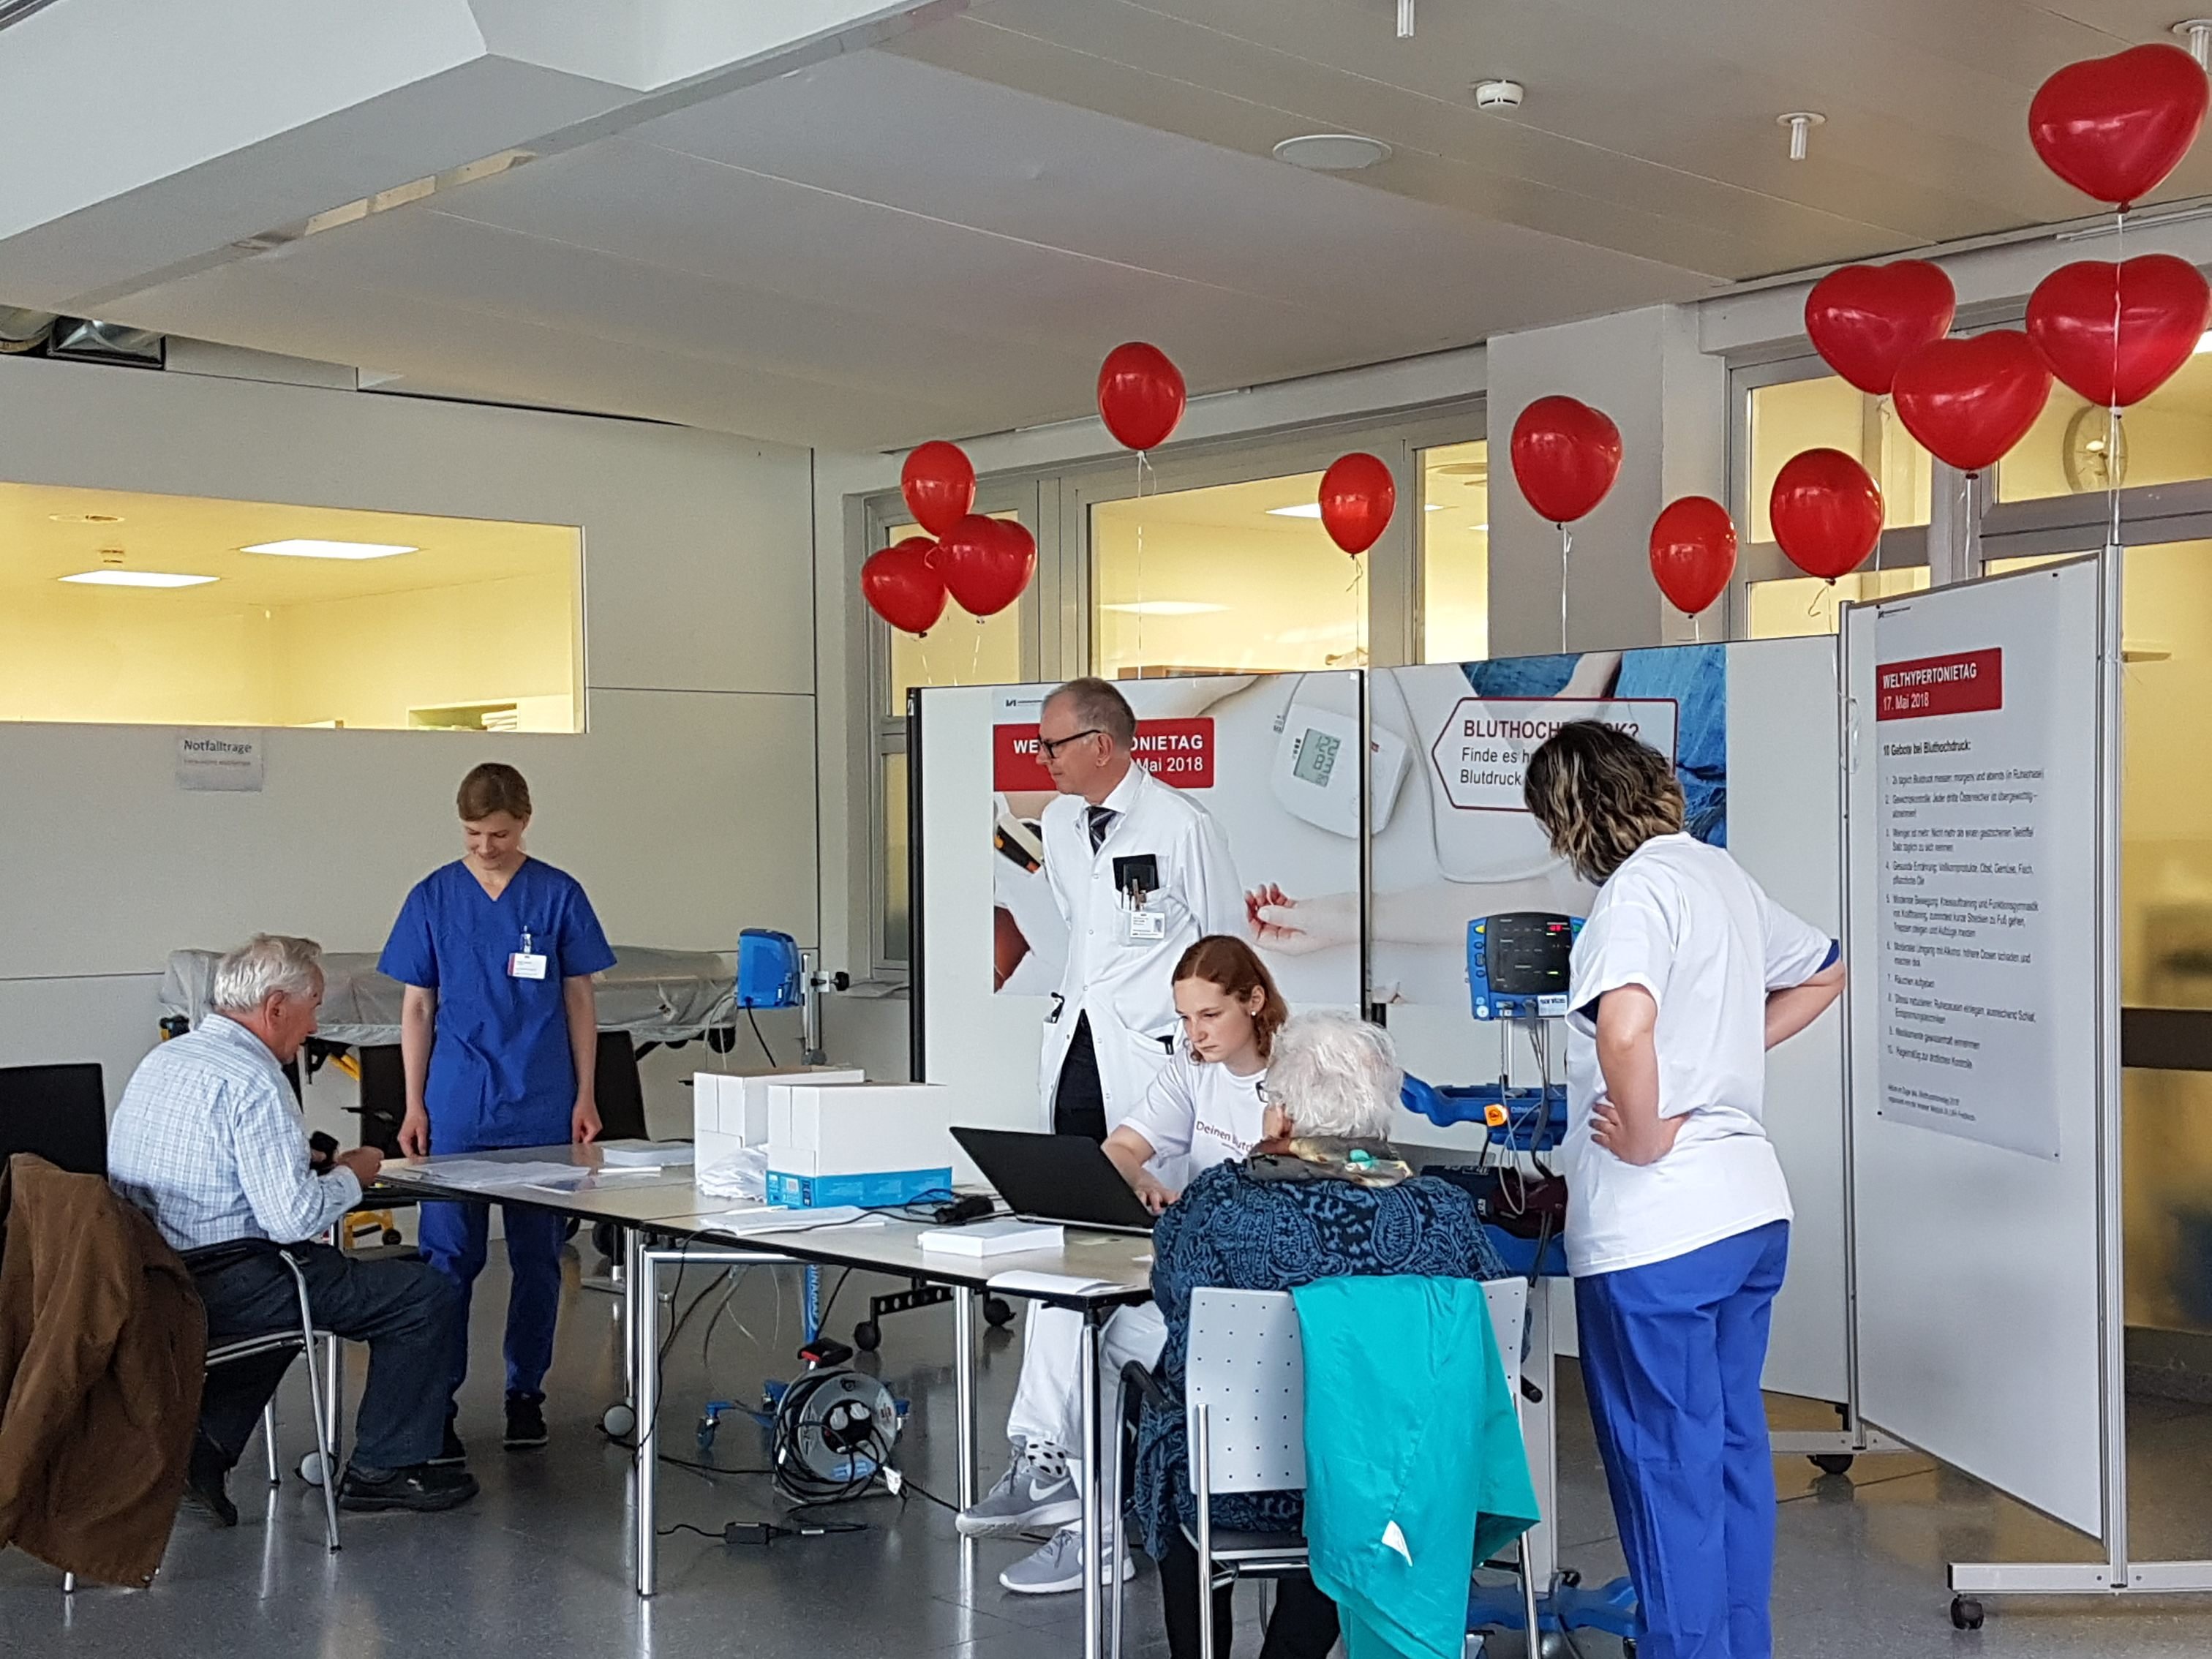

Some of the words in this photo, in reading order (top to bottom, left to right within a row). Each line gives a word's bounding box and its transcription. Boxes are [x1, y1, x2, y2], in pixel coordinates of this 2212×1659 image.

[1883, 663, 1977, 689] WELTHYPERTONIETAG
[1884, 696, 1894, 711] 17.
[1895, 694, 1909, 710] Mai
[1911, 692, 1930, 708] 2018
[1464, 720, 1639, 739] BLUTHOCHK?
[184, 740, 252, 755] Notfalltrage
[1462, 747, 1498, 762] Finde
[1502, 751, 1518, 763] es
[1136, 757, 1162, 771] Mai
[1167, 756, 1203, 772] 2018
[1460, 769, 1522, 786] Blutdruck
[1196, 1121, 1231, 1141] Deinen
